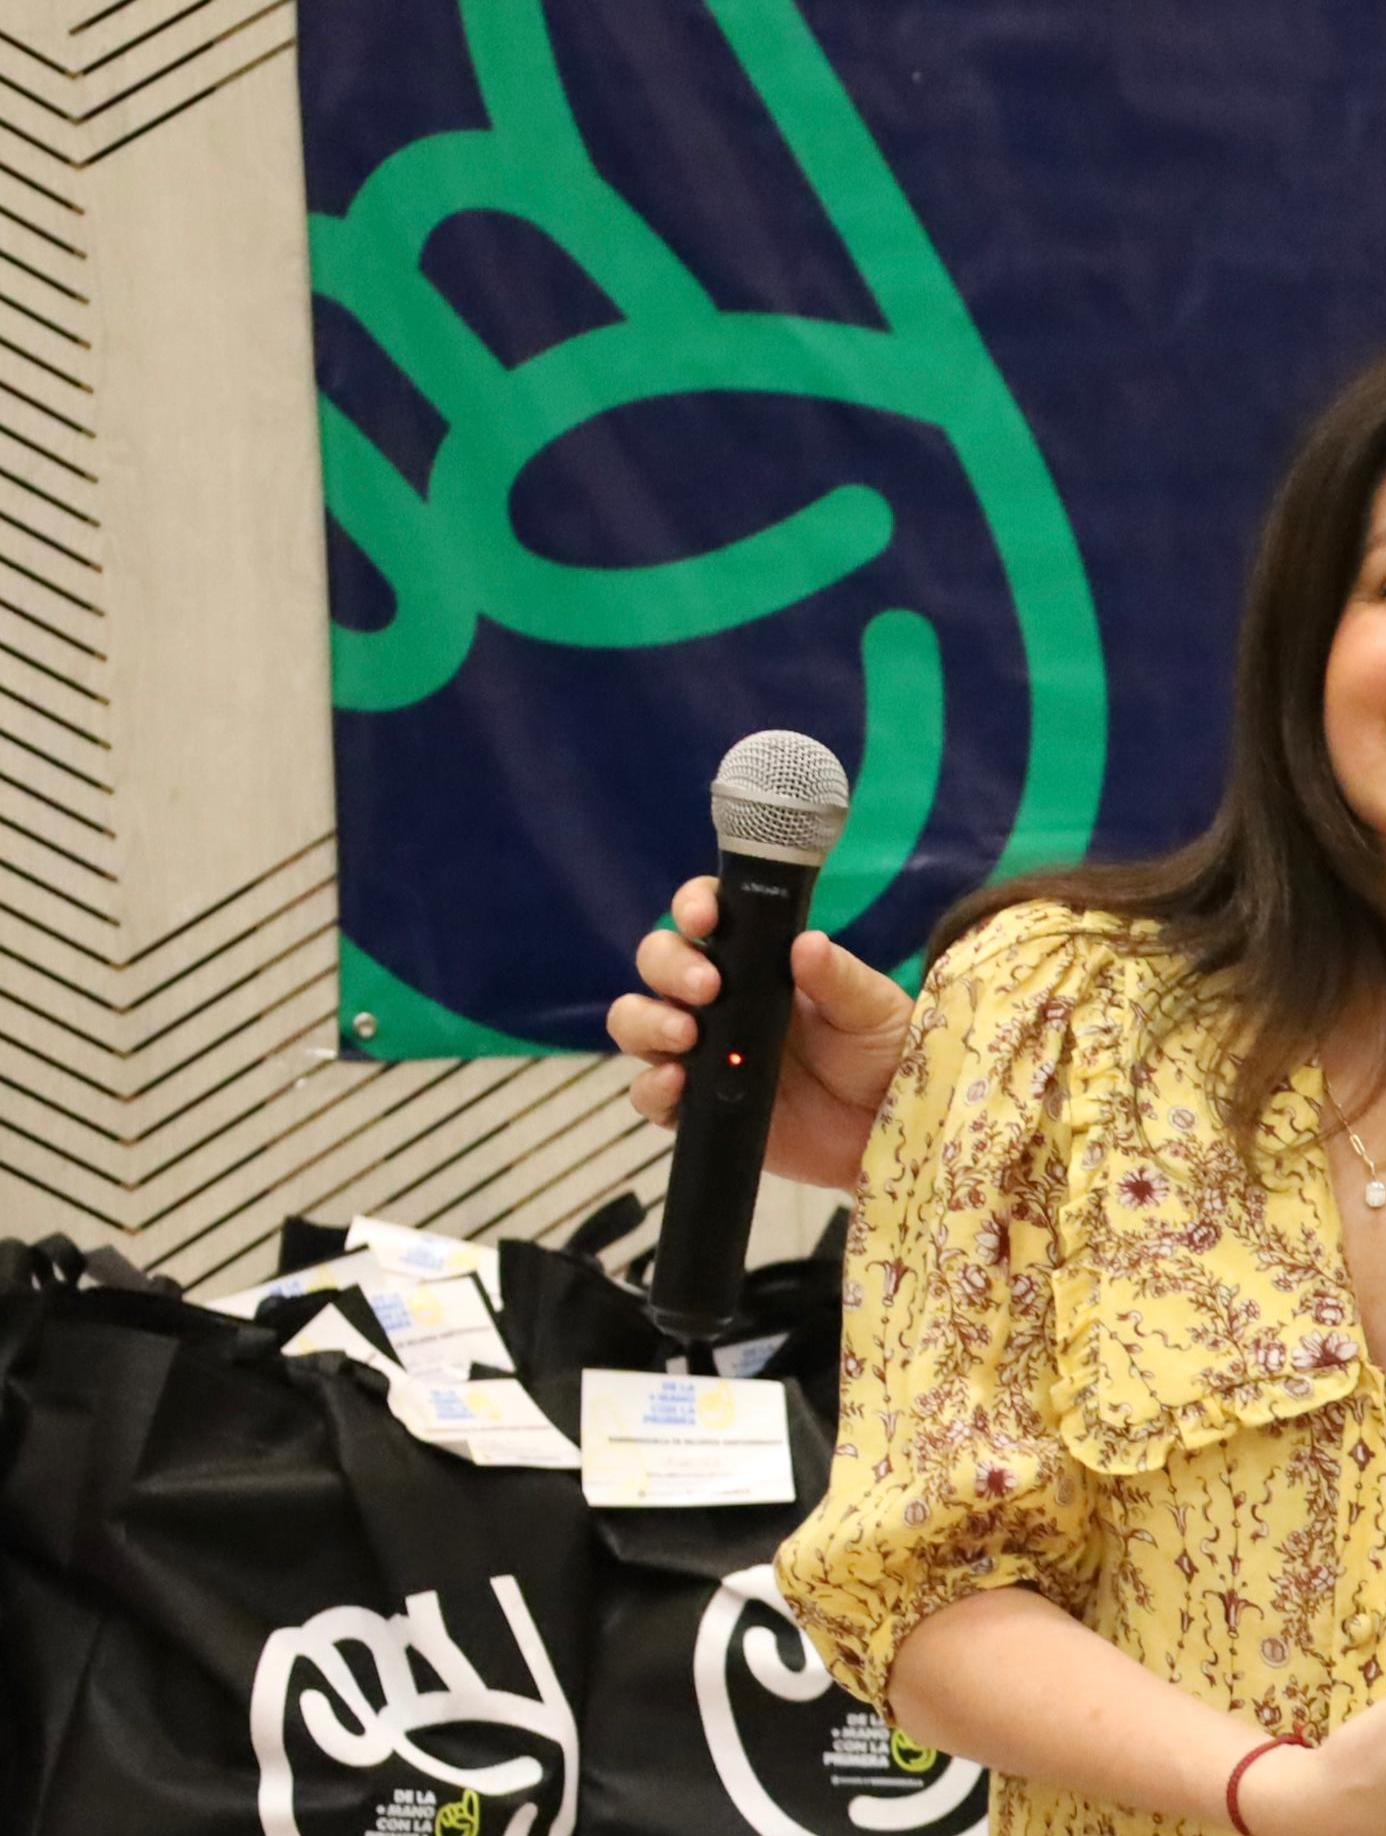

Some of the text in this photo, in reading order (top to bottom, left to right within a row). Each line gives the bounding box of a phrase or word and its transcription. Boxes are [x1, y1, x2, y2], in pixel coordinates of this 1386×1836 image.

[416, 1790, 437, 1805] LA
[376, 1816, 433, 1833] CON LA
